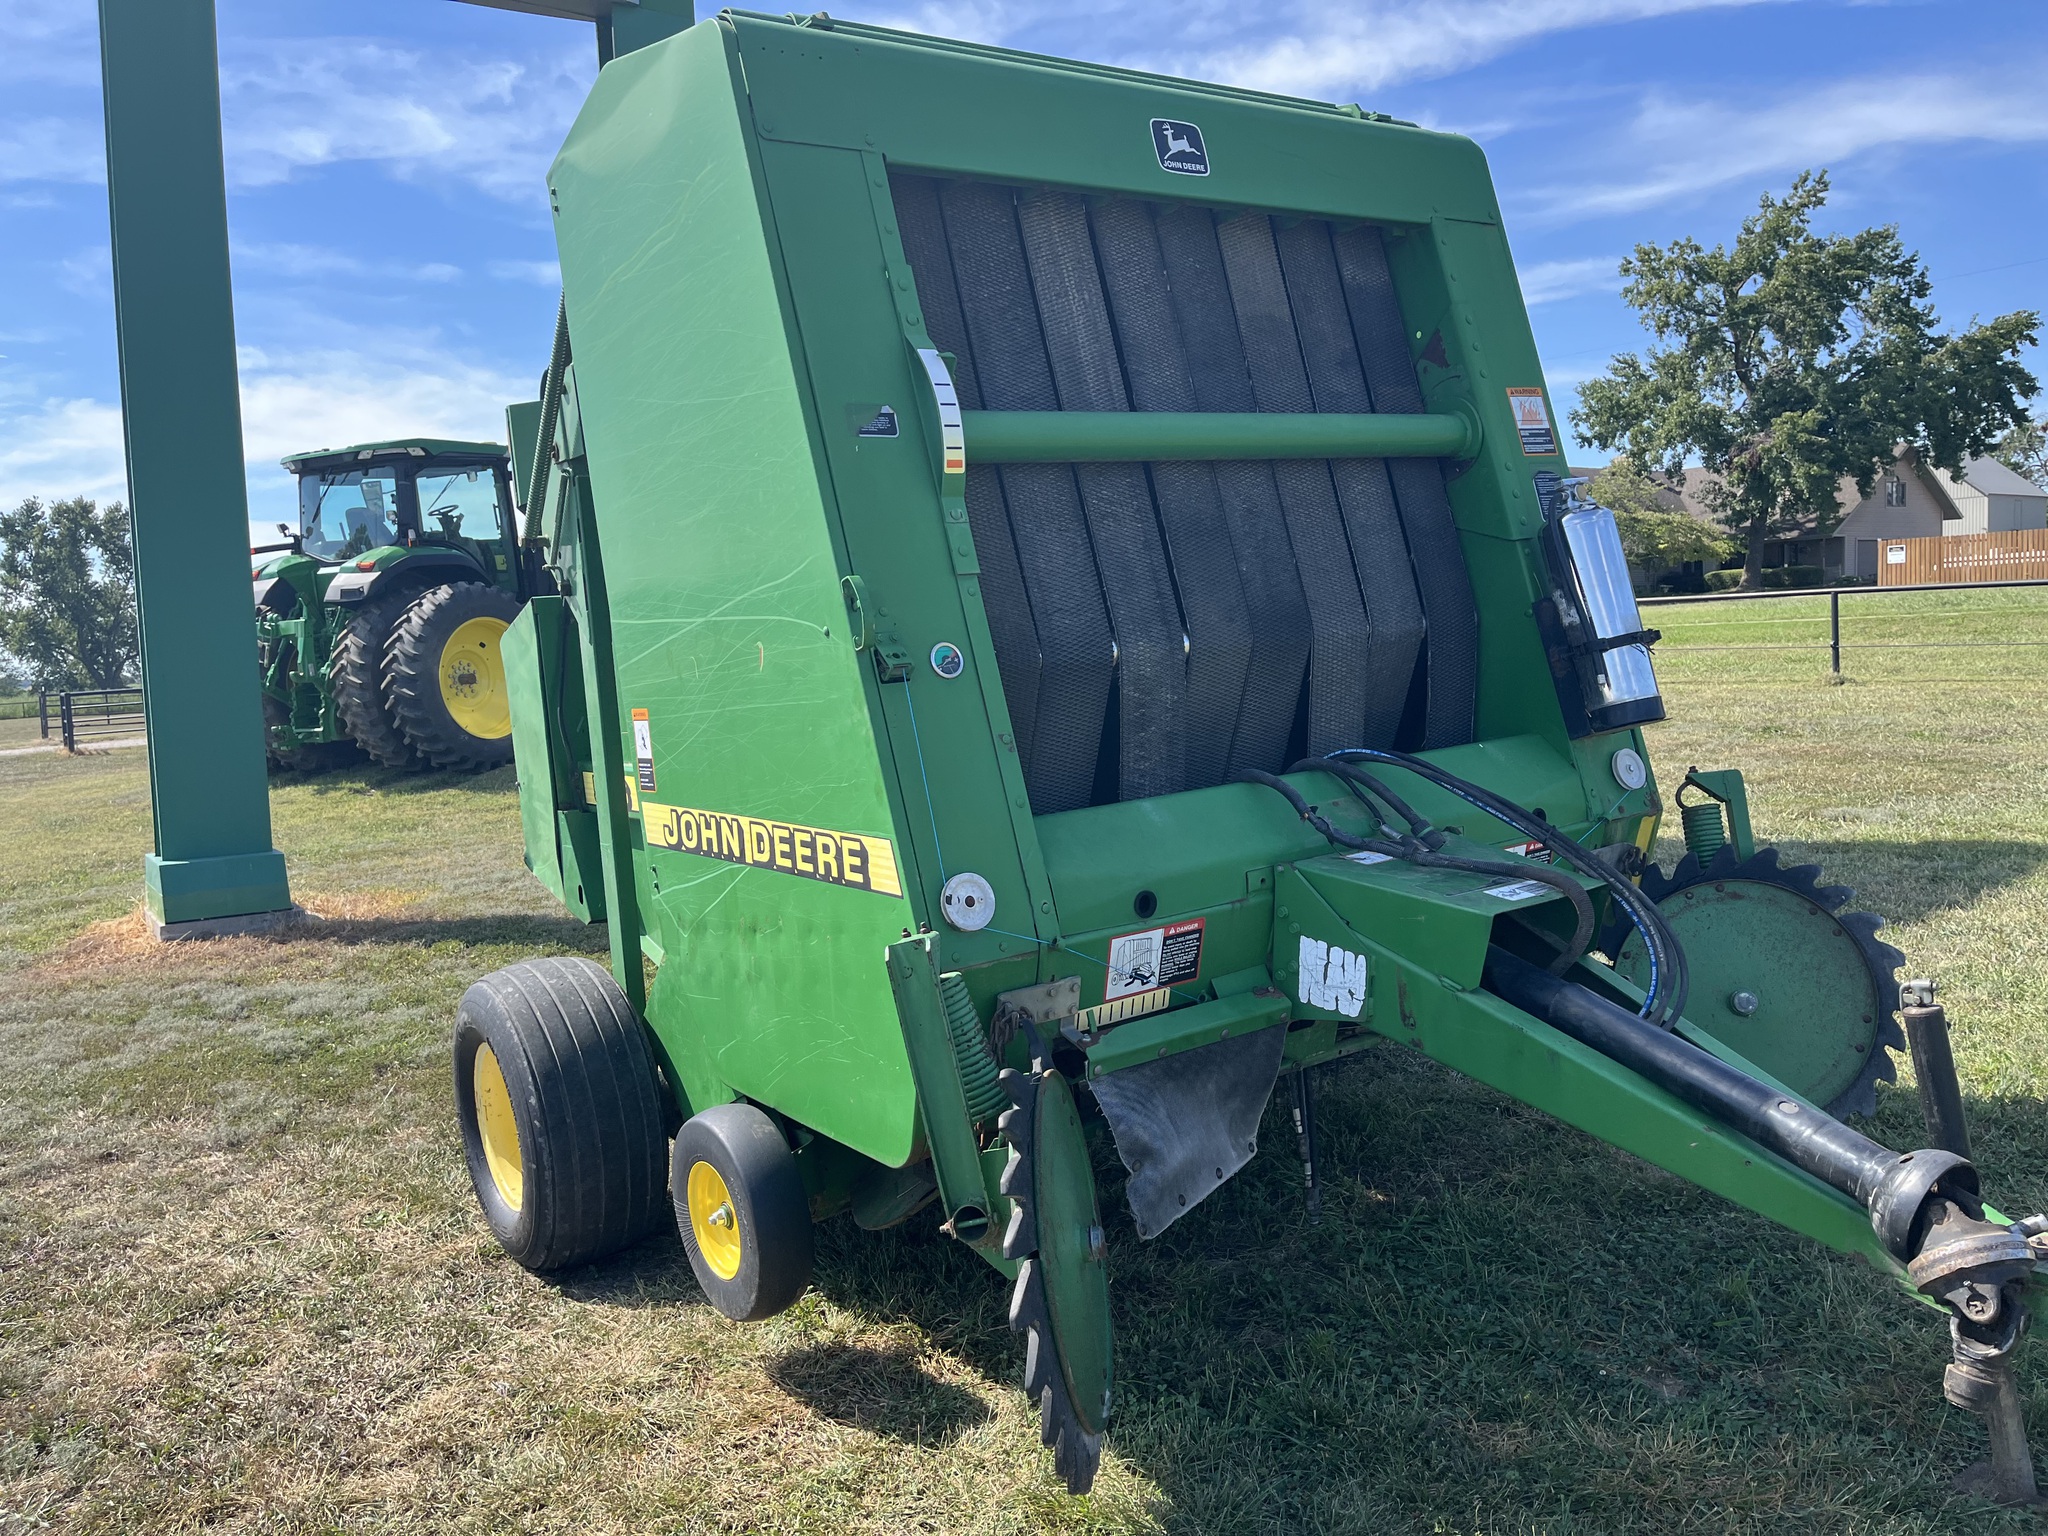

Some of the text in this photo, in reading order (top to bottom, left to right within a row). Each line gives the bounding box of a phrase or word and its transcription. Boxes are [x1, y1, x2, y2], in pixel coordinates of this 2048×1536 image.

[1163, 160, 1205, 172] JOHN DEERE
[663, 808, 867, 885] JOHN DEERE
[1176, 923, 1199, 933] DANGER
